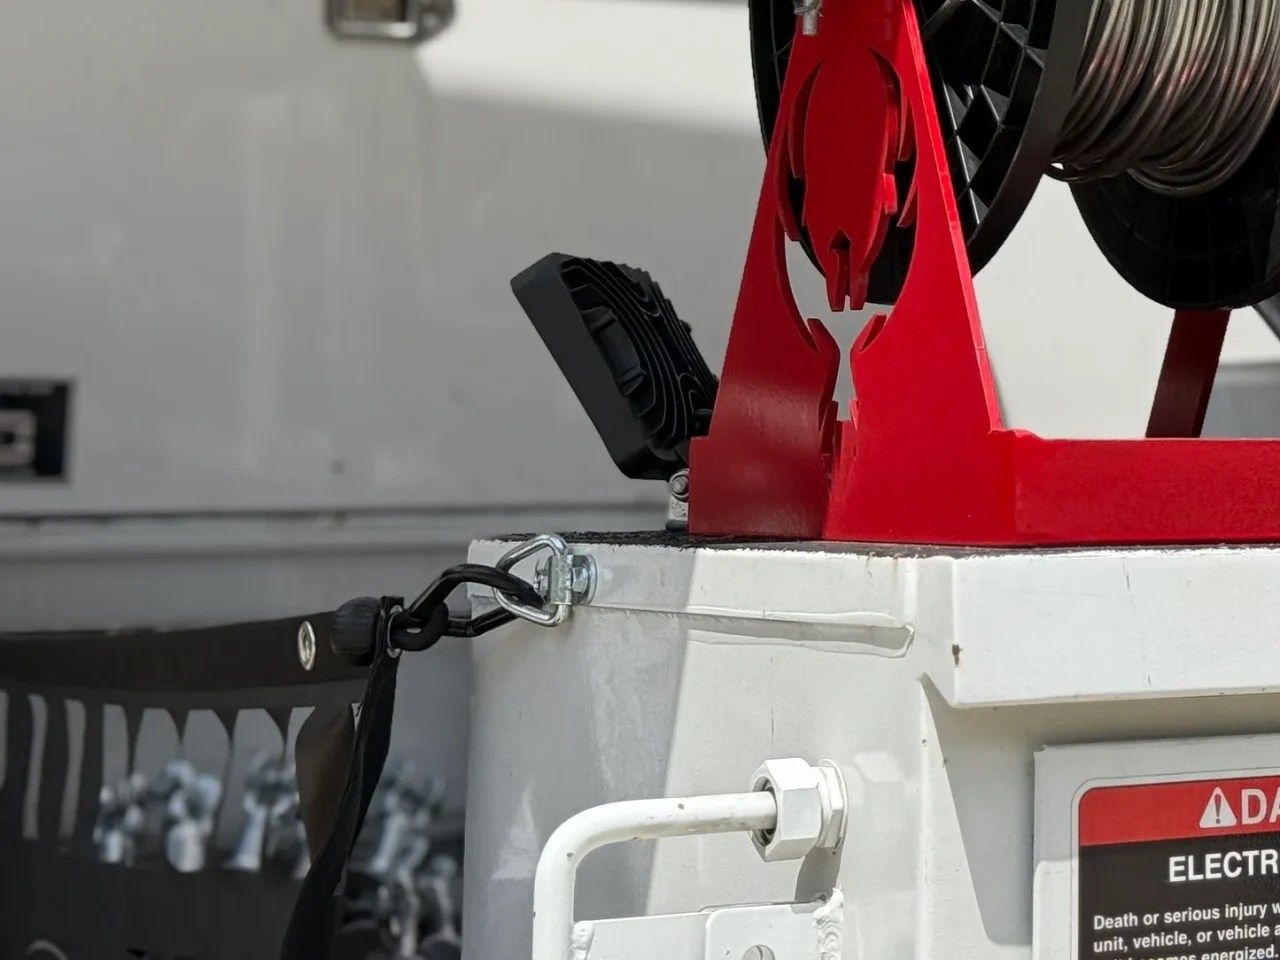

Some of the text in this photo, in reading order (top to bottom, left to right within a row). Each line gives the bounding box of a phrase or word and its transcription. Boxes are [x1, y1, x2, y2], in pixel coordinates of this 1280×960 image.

[1093, 912, 1138, 930] Death
[1143, 913, 1160, 926] or
[1163, 907, 1220, 924] serious
[1225, 902, 1267, 920] injury
[1093, 936, 1128, 953] unit,
[1133, 930, 1192, 949] vehicle,
[1196, 930, 1212, 943] or
[1217, 923, 1270, 941] vehicle
[1201, 944, 1279, 960] energized.
